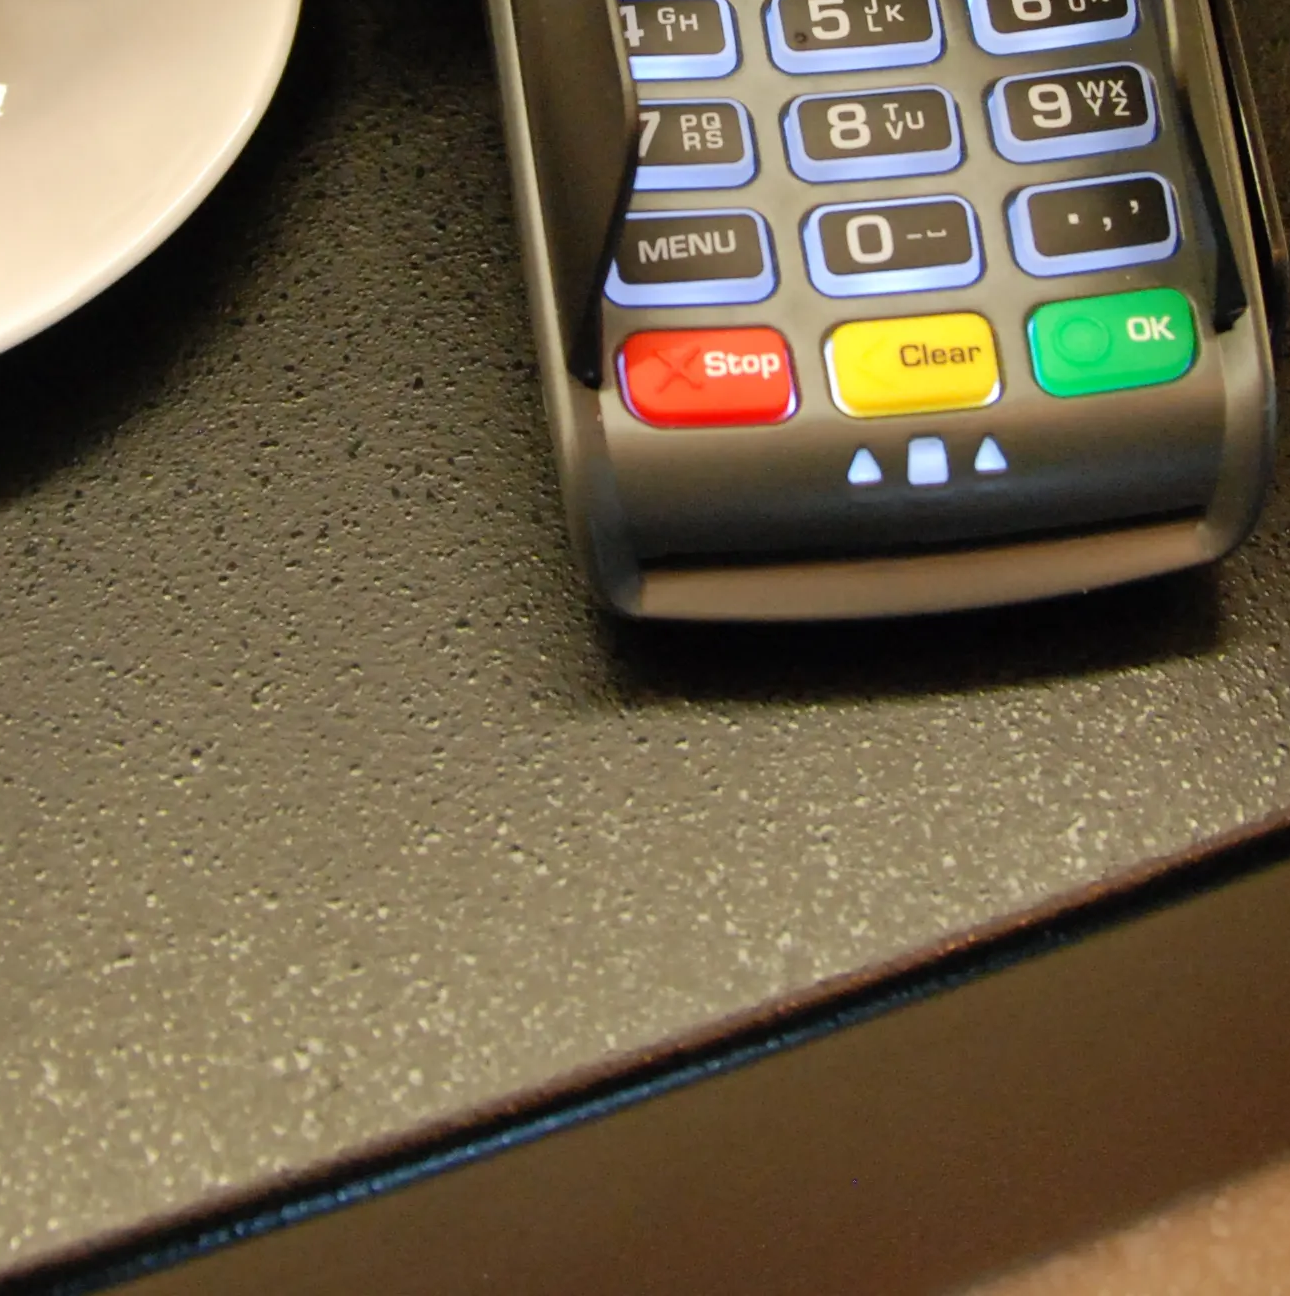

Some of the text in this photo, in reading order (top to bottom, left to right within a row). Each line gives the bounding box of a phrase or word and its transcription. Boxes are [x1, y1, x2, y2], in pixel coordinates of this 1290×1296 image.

[1028, 83, 1072, 129] 9
[827, 103, 871, 150] 8
[638, 230, 737, 264] MENU
[1126, 315, 1176, 343] OK
[705, 351, 780, 380] Stop
[899, 343, 982, 369] Clear
